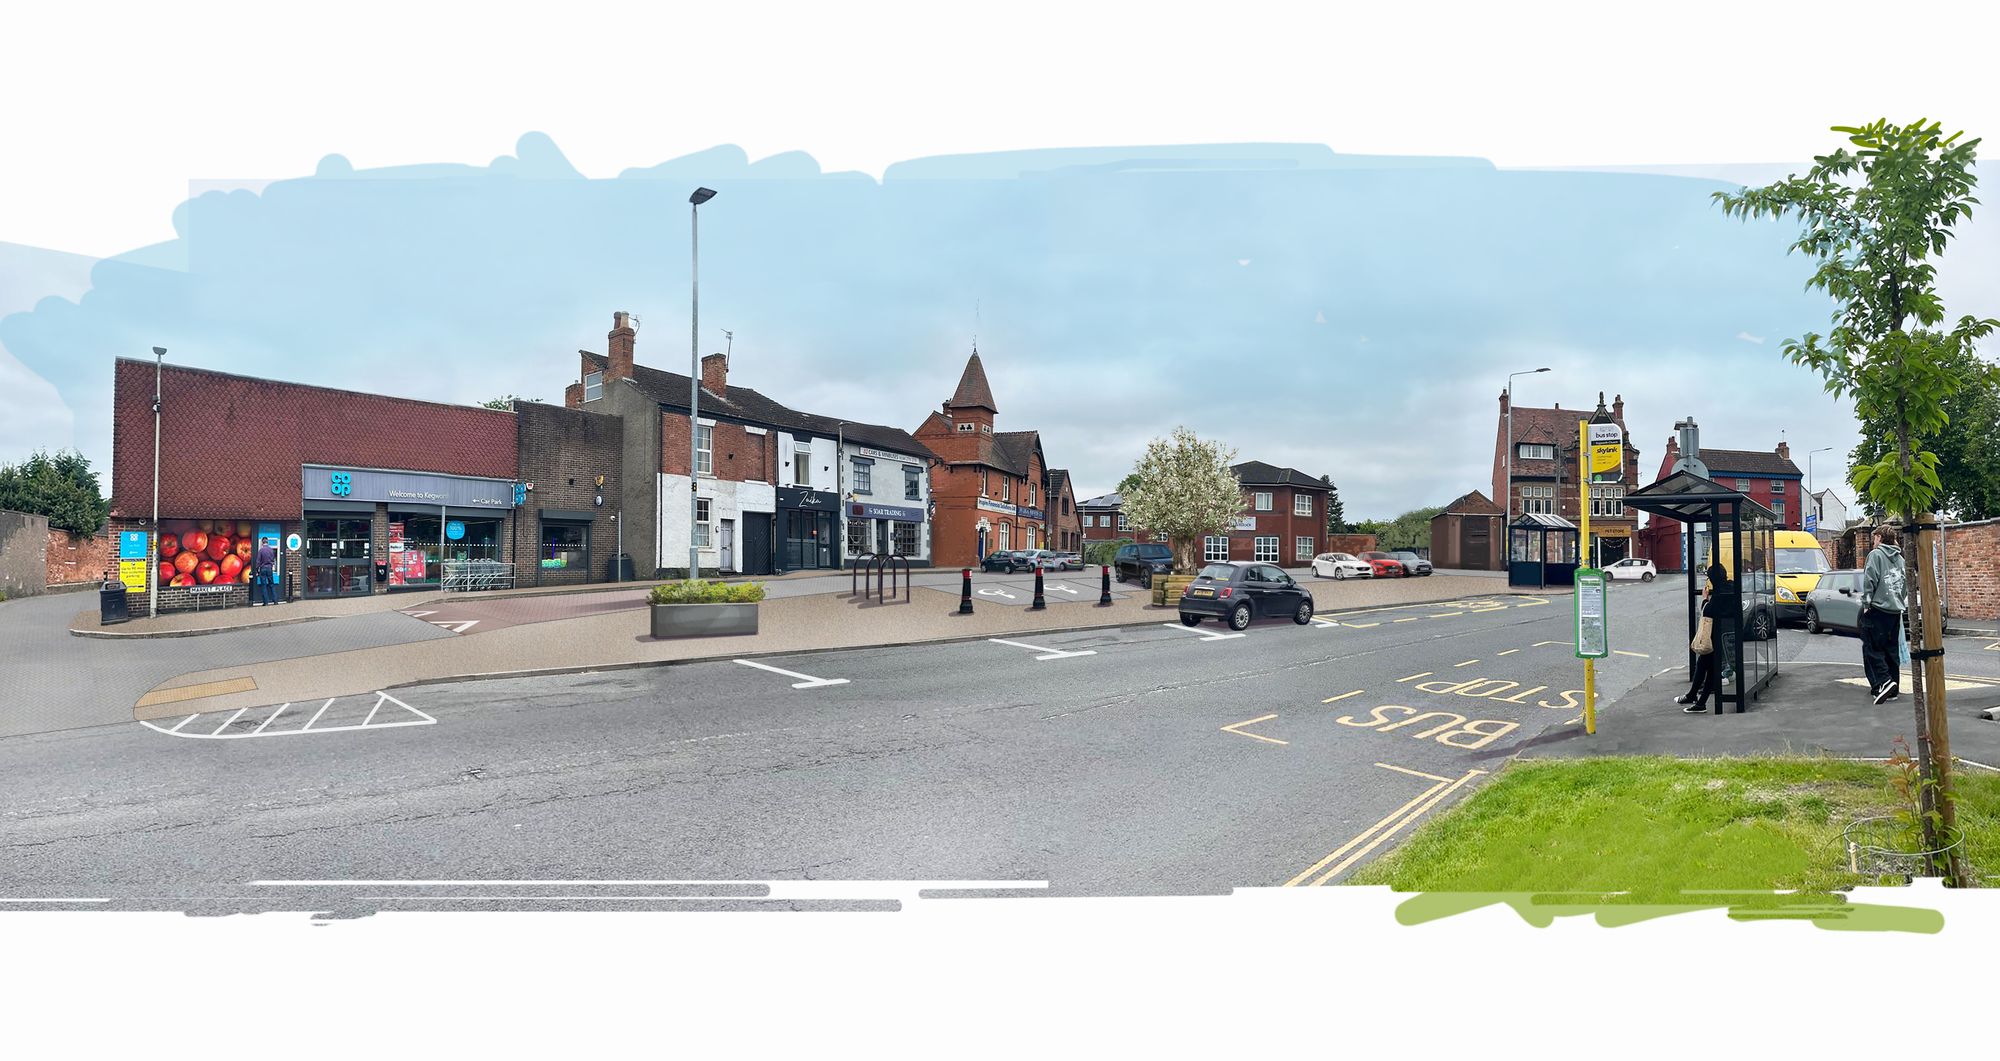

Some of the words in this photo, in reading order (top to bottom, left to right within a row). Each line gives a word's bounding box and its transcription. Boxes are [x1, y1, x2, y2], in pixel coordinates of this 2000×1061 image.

[389, 490, 416, 499] Welcome
[1415, 678, 1598, 709] STOP
[1336, 705, 1519, 750] BUS
